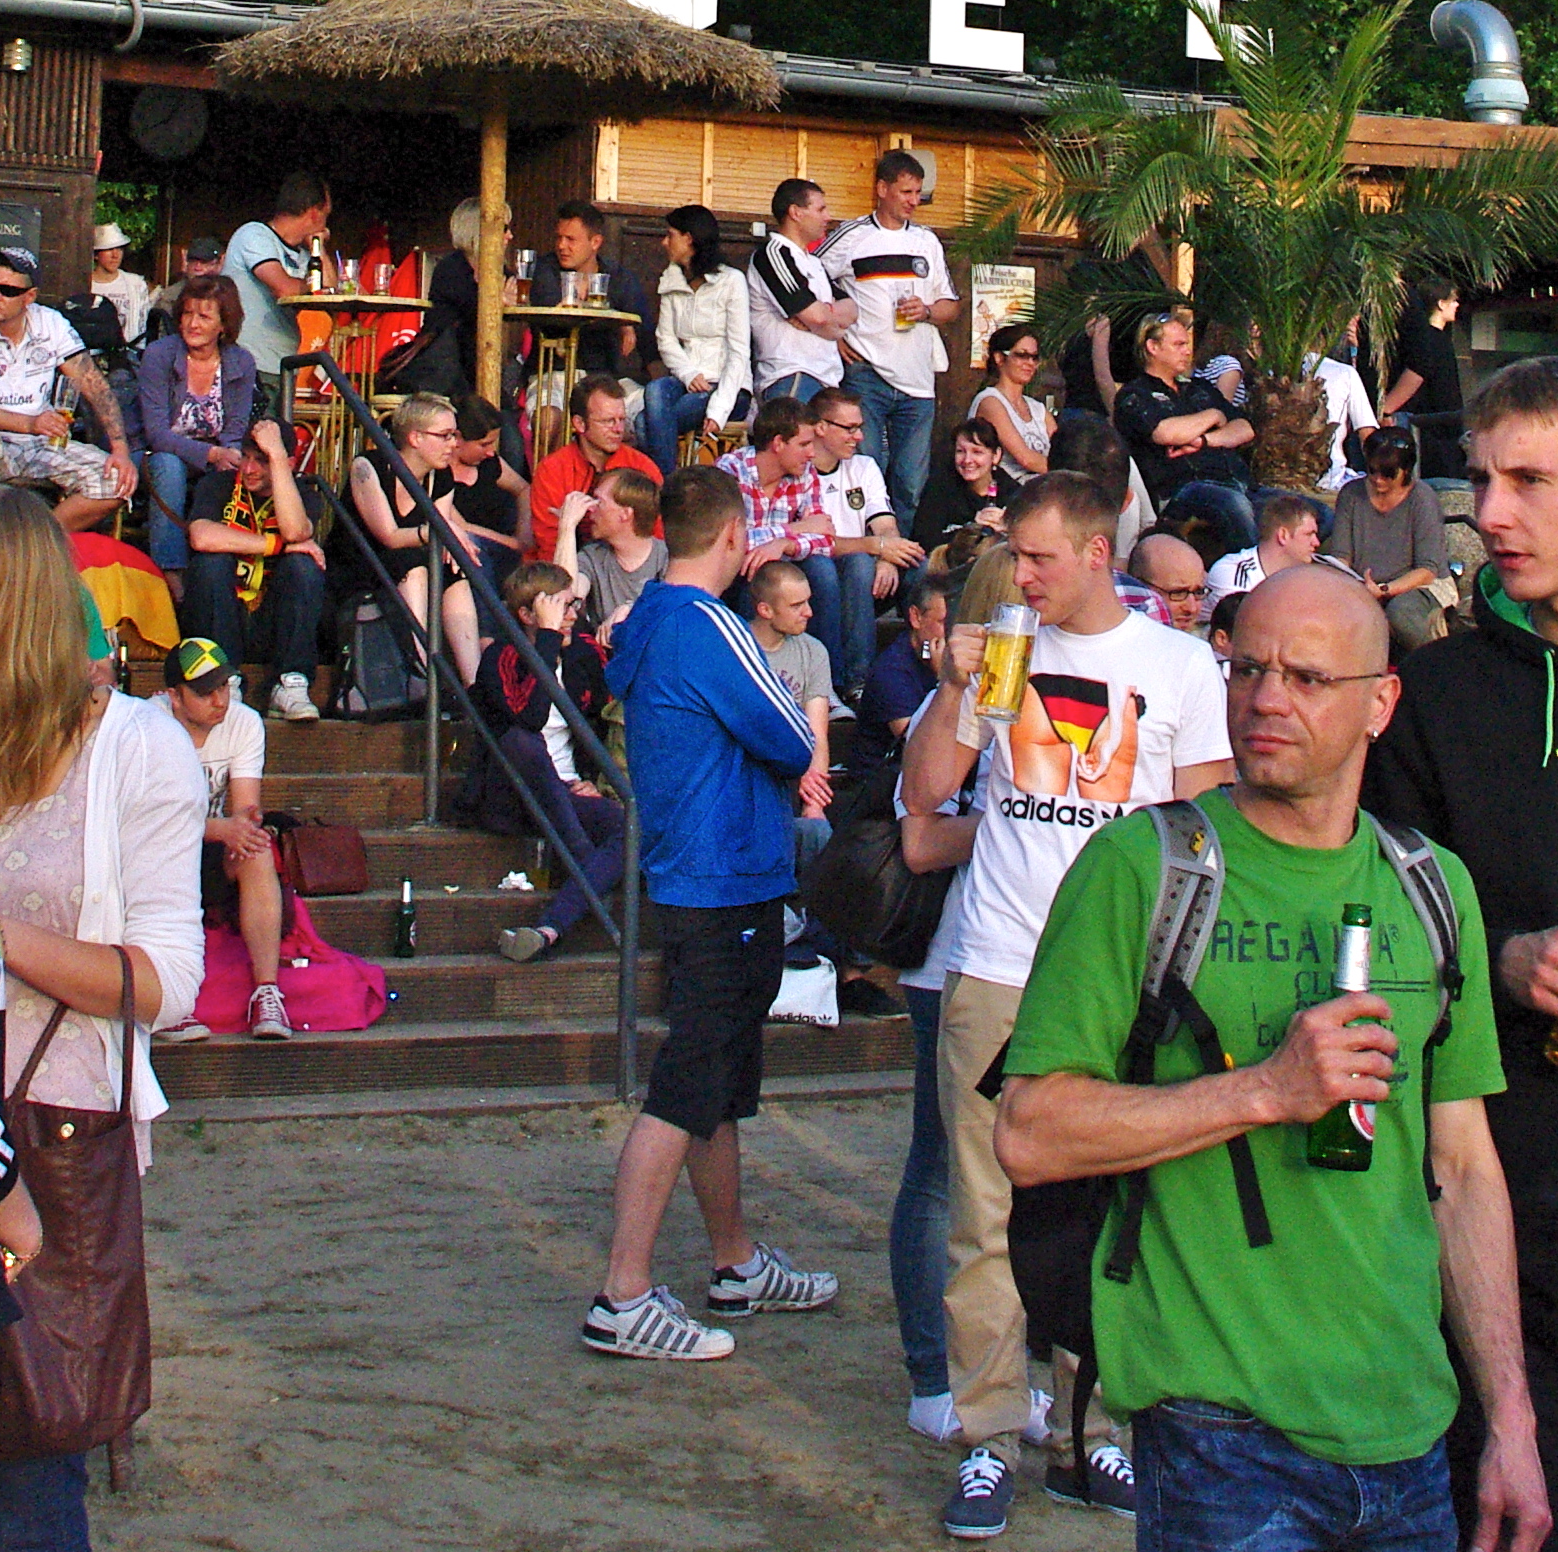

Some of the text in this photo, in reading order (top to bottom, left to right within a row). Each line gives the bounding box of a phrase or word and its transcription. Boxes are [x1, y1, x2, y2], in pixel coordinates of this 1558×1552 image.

[999, 793, 1095, 828] adidas
[1210, 918, 1395, 964] REGAA
[771, 1012, 817, 1024] adidas
